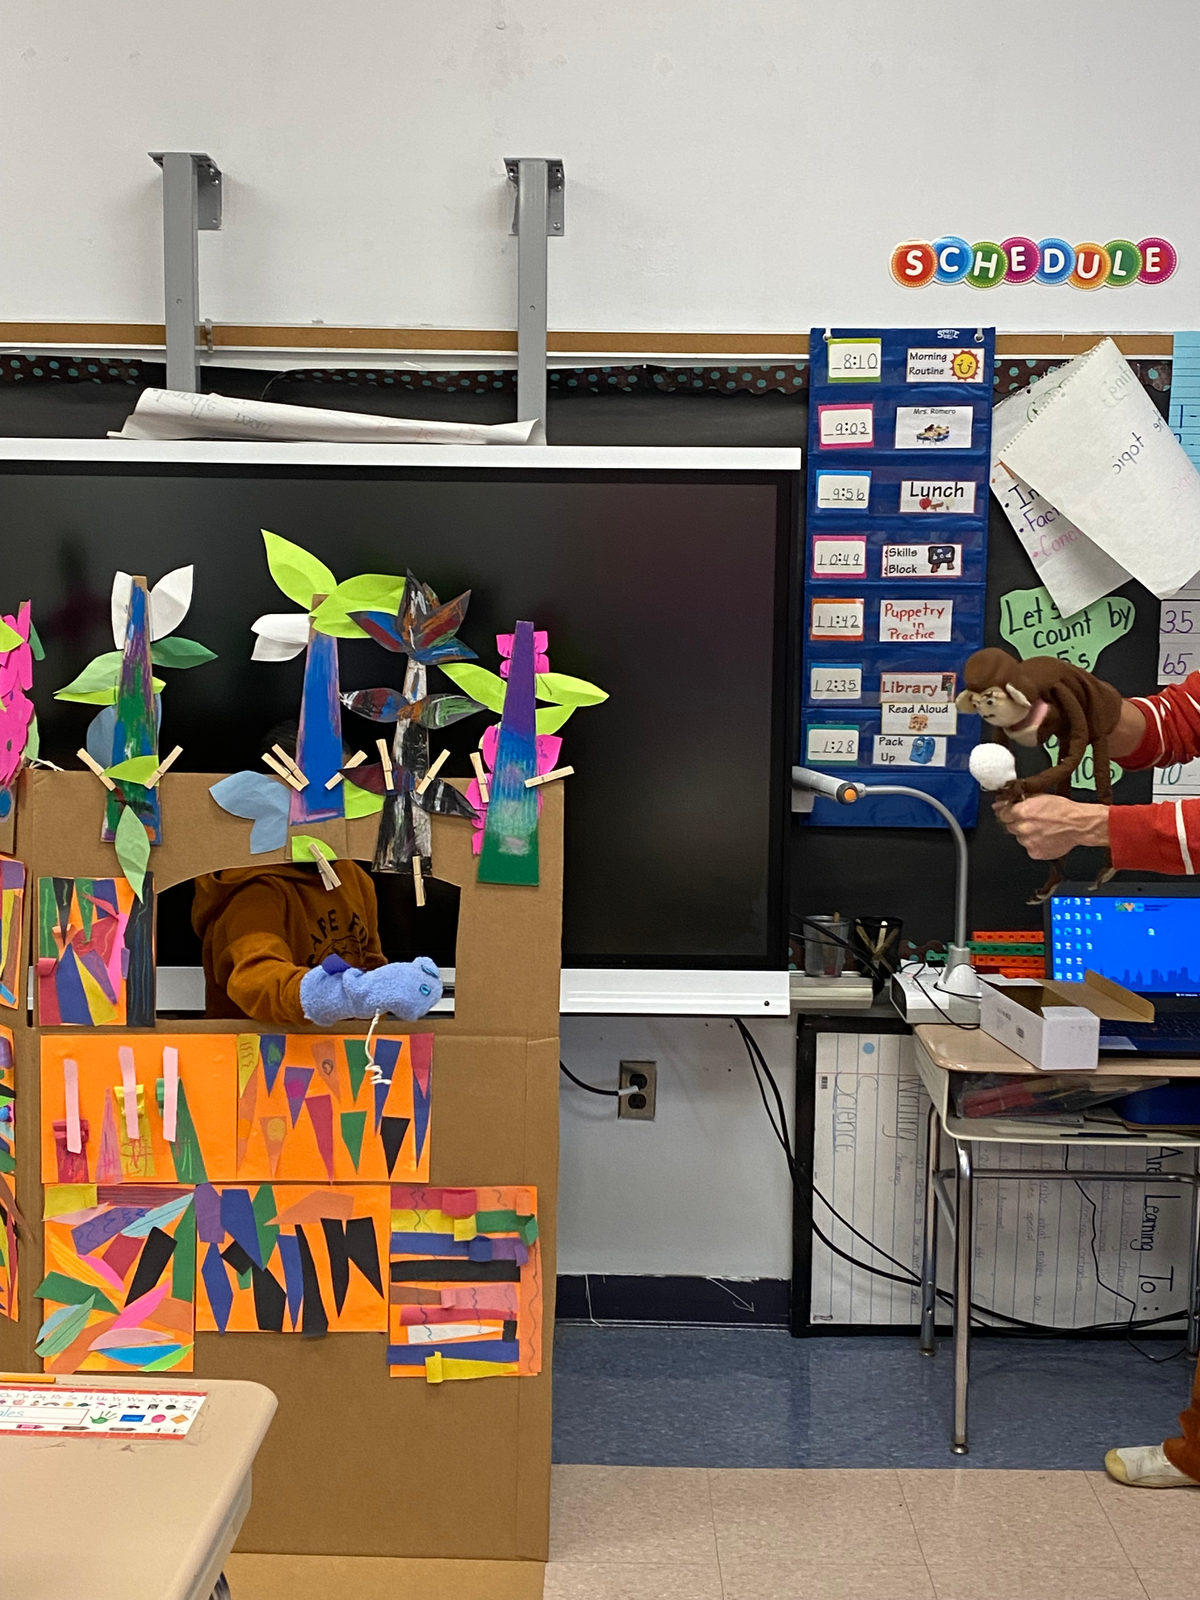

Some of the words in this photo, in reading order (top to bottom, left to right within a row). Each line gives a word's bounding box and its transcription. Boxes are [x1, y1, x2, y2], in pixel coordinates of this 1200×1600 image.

[905, 245, 1162, 279] SCHEDULE
[843, 352, 878, 369] 8:10
[909, 352, 947, 362] Morning
[908, 366, 945, 375] Routine
[835, 421, 868, 435] 9:03
[832, 487, 866, 501] 9:56
[910, 481, 964, 499] Lunch
[888, 547, 918, 557] Skills
[817, 553, 861, 566] 10:49
[888, 564, 918, 574] Block
[884, 602, 945, 622] Puppetry
[816, 615, 859, 628] 11:42
[912, 619, 925, 629] in
[1033, 610, 1092, 649] count
[1106, 601, 1132, 631] by
[1160, 609, 1194, 634] 35
[887, 628, 935, 640] Practice
[1162, 653, 1193, 676] 65
[813, 679, 857, 692] 12:35
[881, 682, 938, 697] Library
[888, 704, 915, 714] Read
[917, 704, 949, 714] Aloud
[823, 740, 855, 753] 1:28
[878, 736, 904, 746] Pack
[880, 752, 896, 763] Up
[835, 1074, 879, 1153] Science
[1130, 1194, 1182, 1252] Learning
